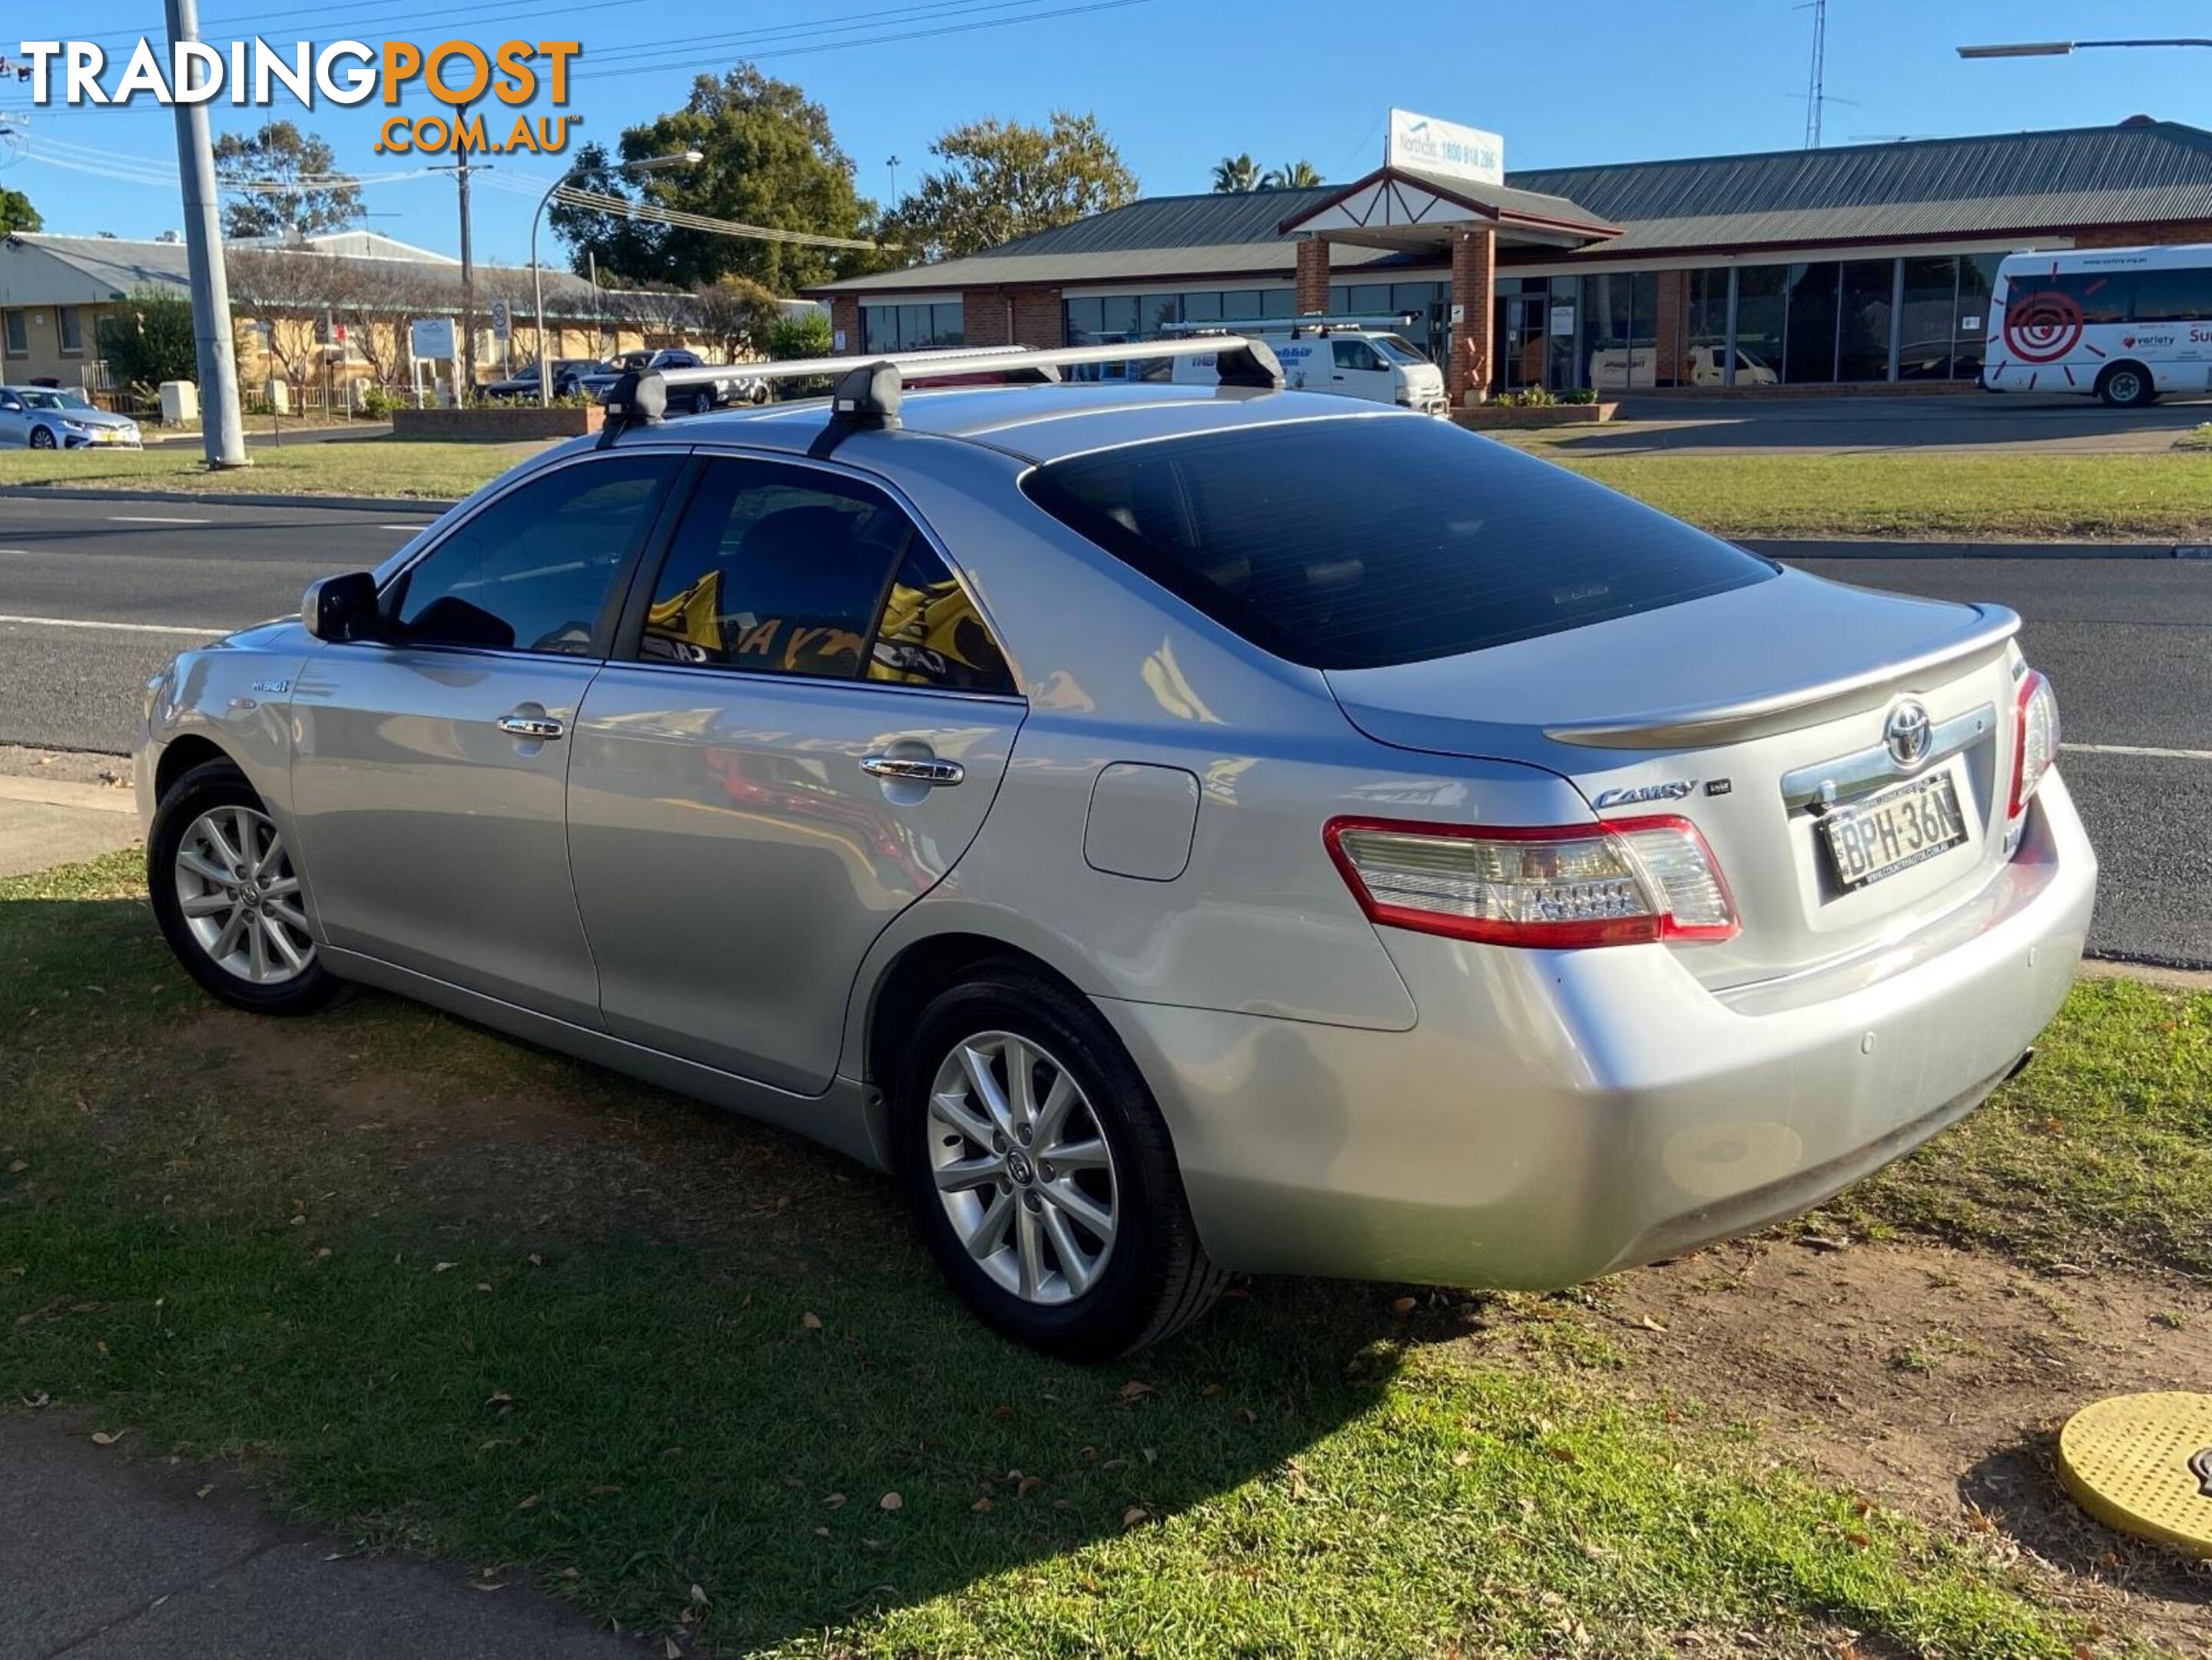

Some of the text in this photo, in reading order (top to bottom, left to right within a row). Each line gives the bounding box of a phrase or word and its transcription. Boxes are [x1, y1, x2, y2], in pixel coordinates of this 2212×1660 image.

[1442, 141, 1462, 162] 1800
[2137, 334, 2175, 345] variety
[1591, 778, 1699, 811] CAMRY
